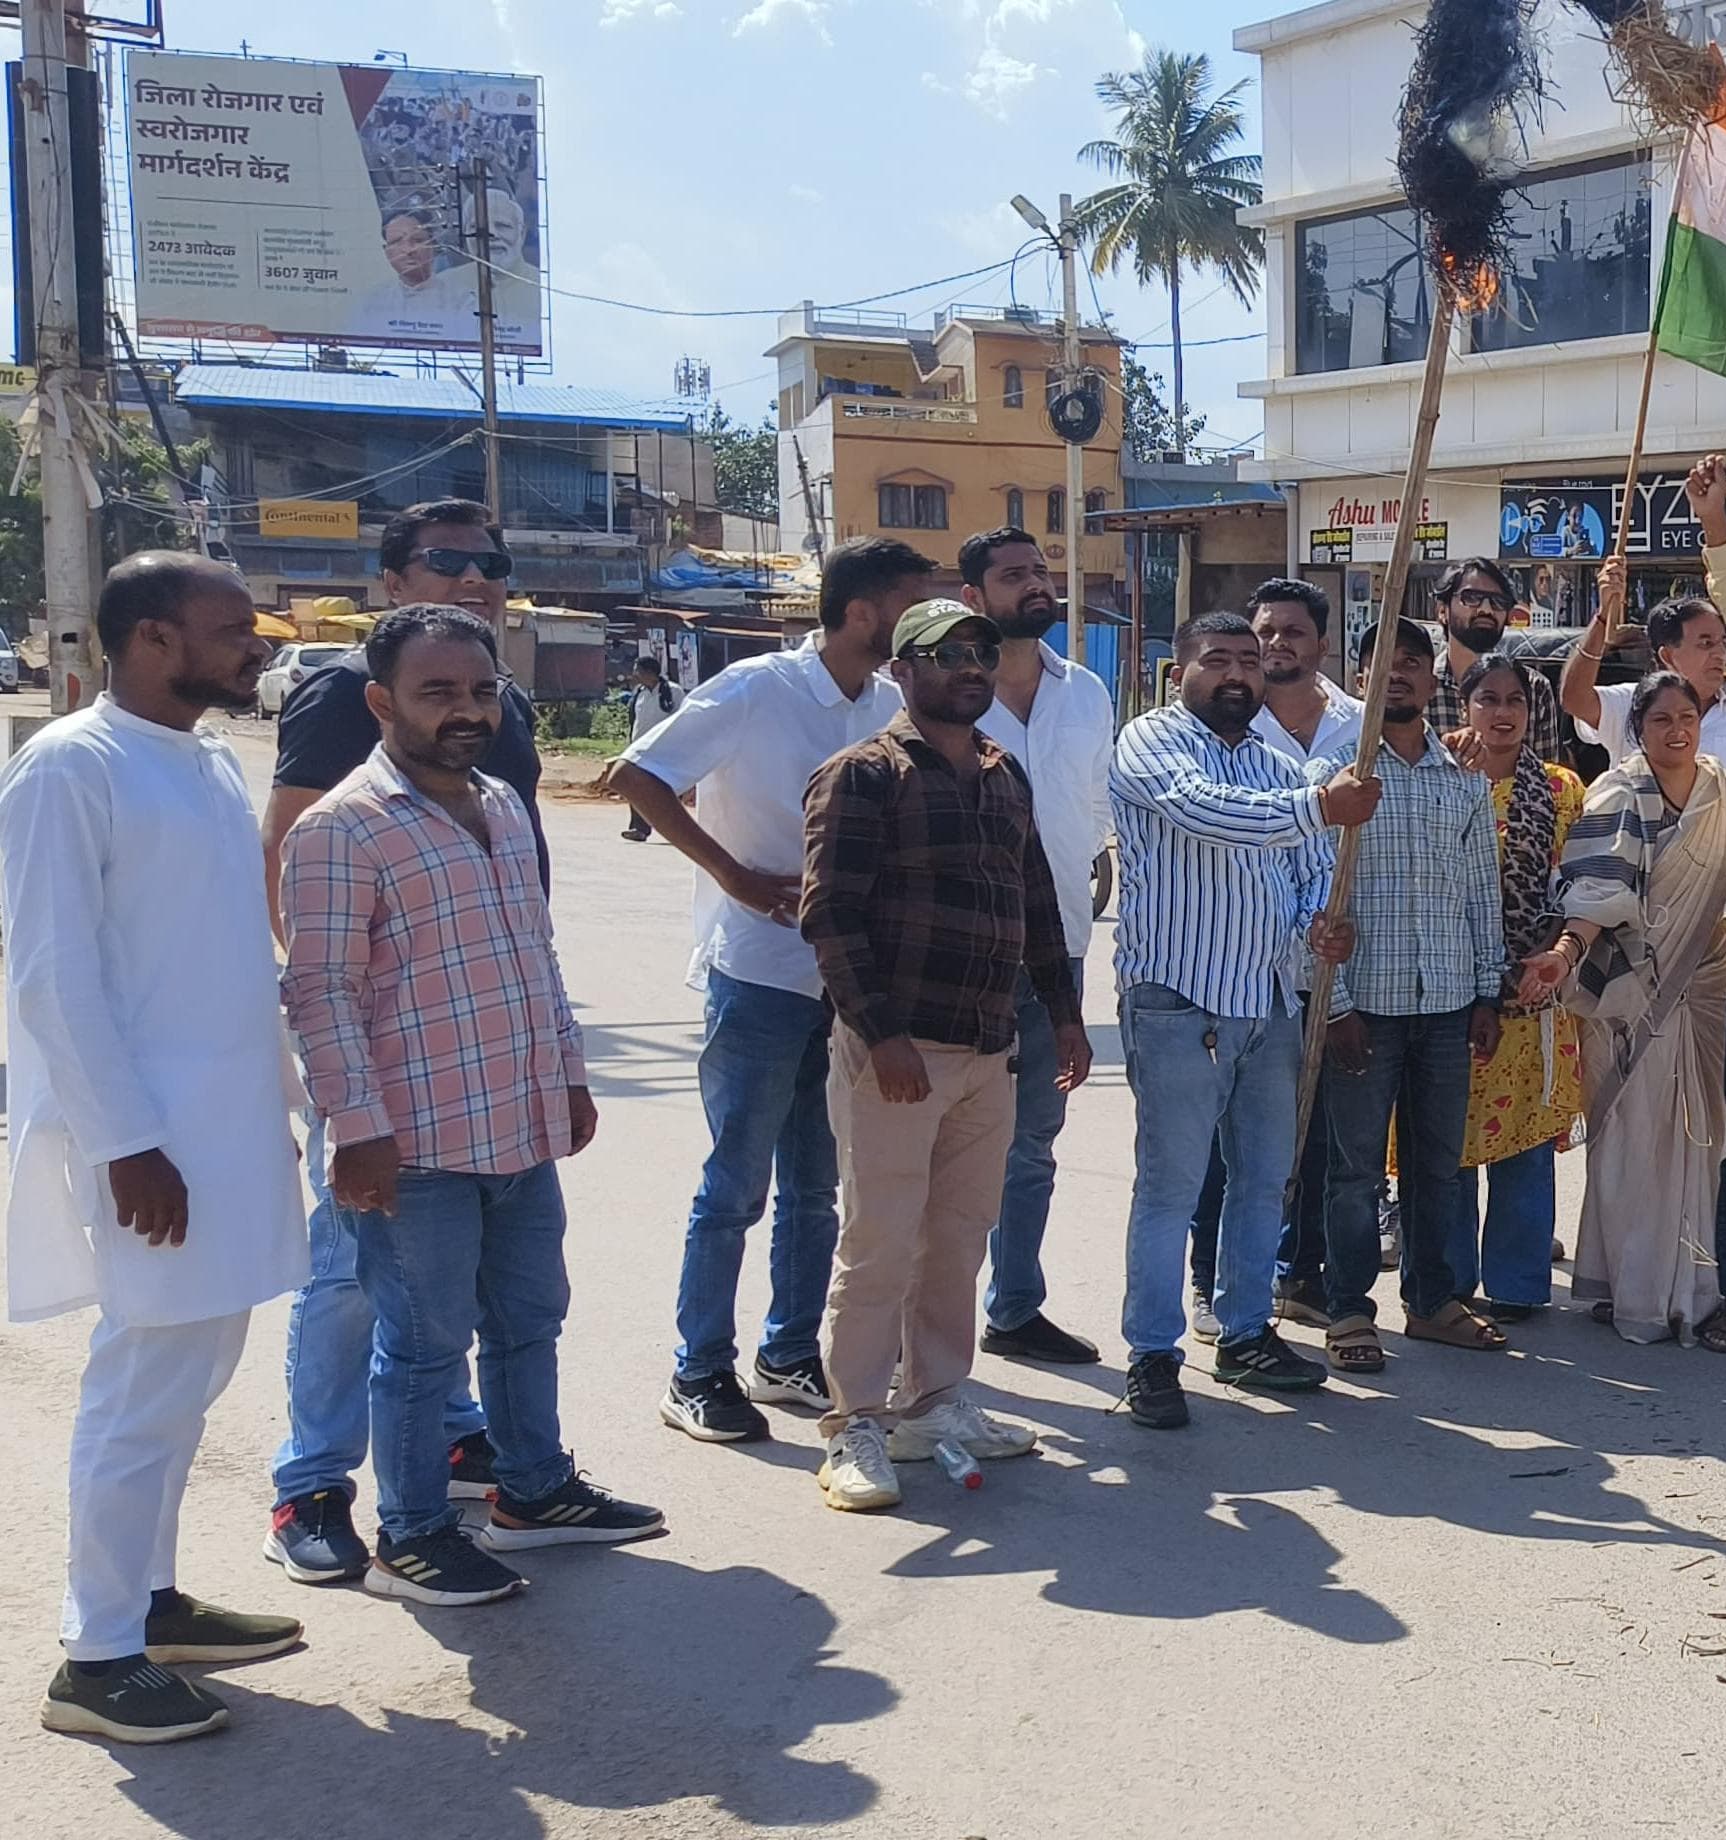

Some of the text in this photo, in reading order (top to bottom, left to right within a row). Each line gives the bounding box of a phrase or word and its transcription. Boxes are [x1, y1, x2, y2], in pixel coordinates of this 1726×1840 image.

[135, 79, 325, 116] जिला रोजगार एवं
[135, 115, 251, 145] स्वरोजगार
[137, 150, 290, 184] मार्गदर्शन केंद्र
[148, 240, 237, 257] 2473 आवेदक
[264, 266, 300, 279] 3607
[265, 507, 340, 524] Continental
[1328, 497, 1430, 530] Ashu MOE
[1661, 530, 1692, 548] EYE
